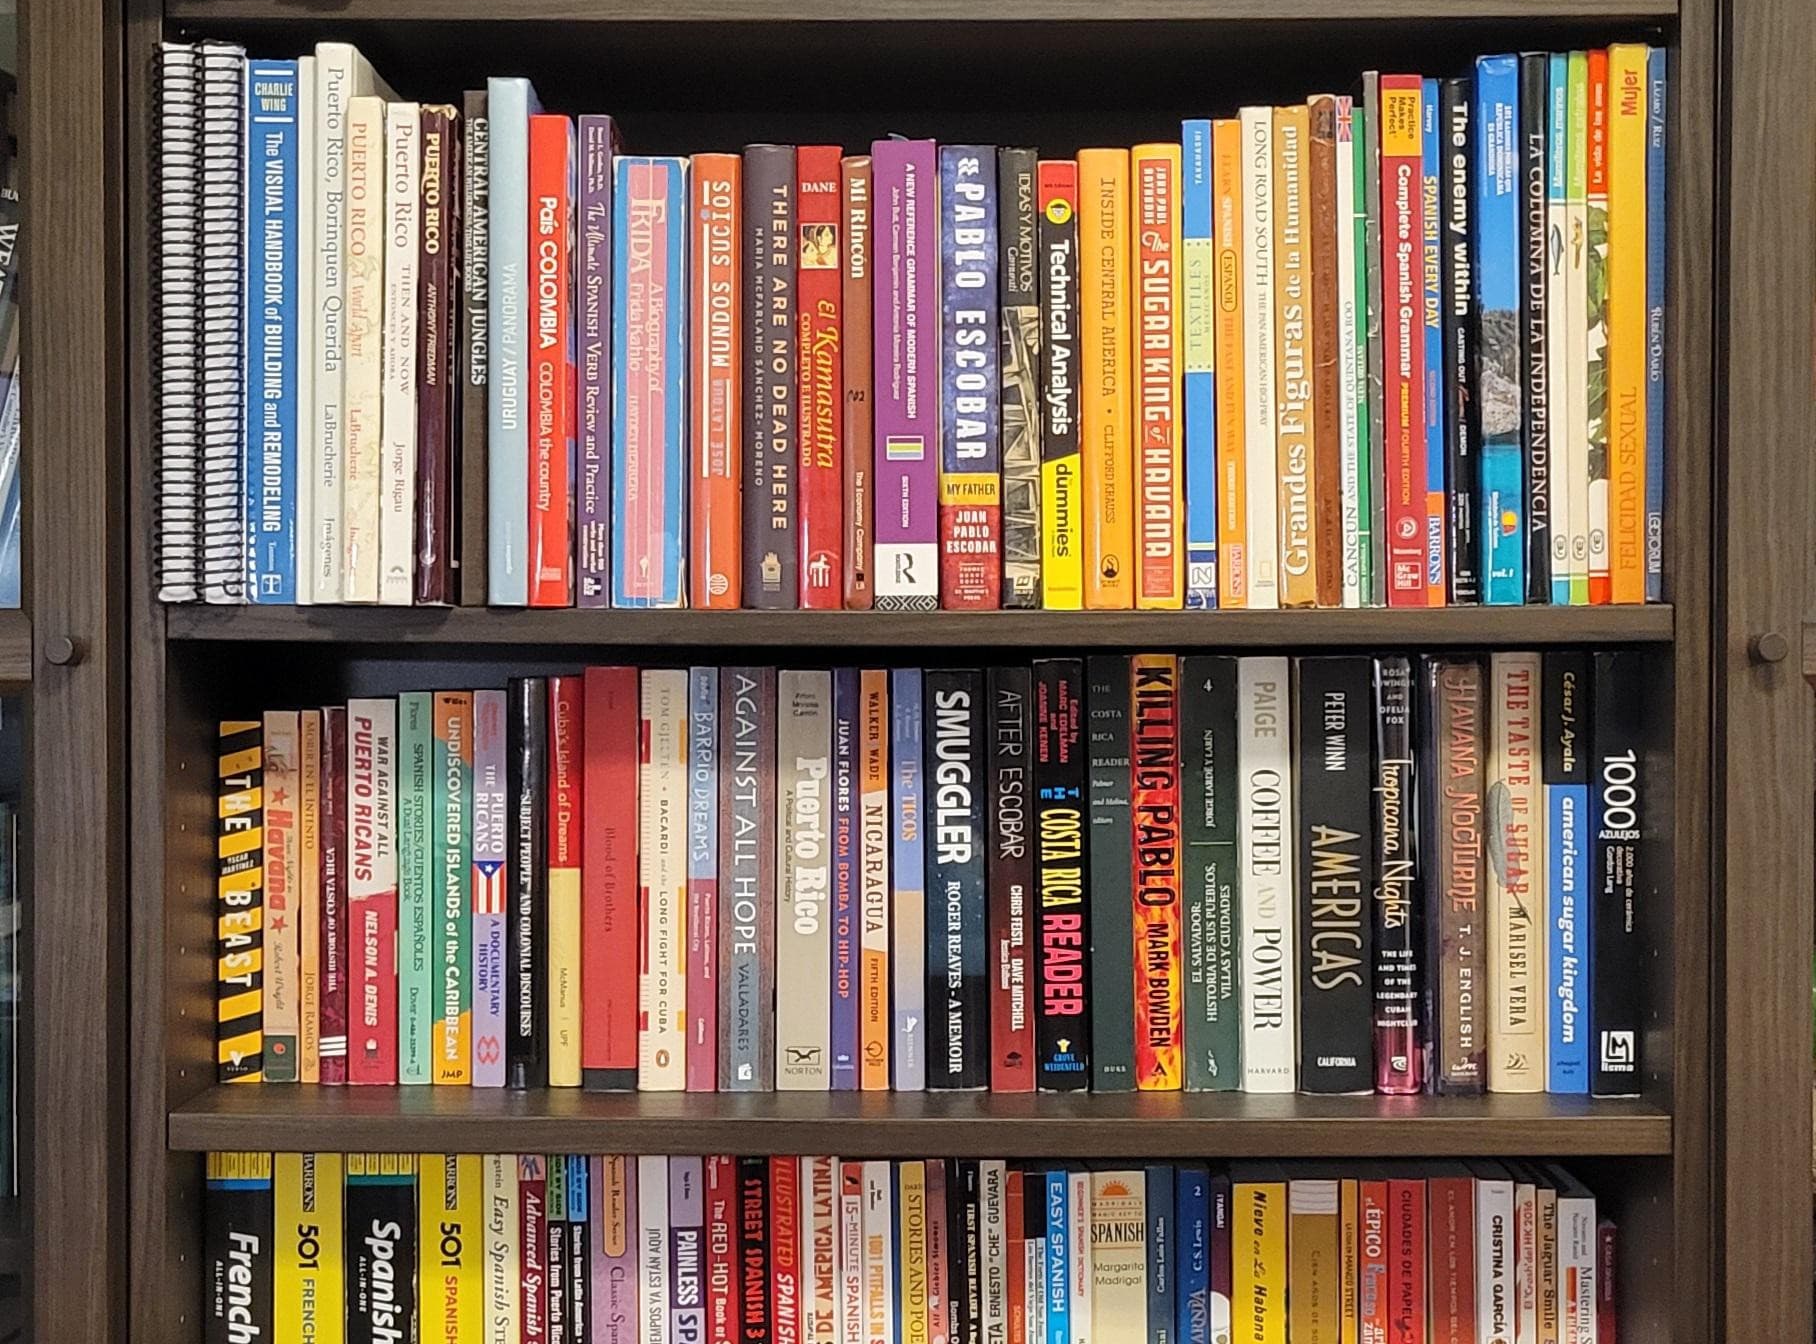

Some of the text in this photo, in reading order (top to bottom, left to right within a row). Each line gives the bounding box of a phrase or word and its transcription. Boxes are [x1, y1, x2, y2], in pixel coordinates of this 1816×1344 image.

[255, 83, 293, 96] CHARLIE
[261, 98, 287, 111] WING
[324, 68, 343, 372] Puerto Rico, Borinquen Querida
[1396, 164, 1413, 378] Complete Spanish Grammar
[1448, 102, 1468, 315] The enemy within
[263, 132, 282, 531] The VISUAL HANDBOOK of BUILDING and REMODELING
[772, 186, 787, 530] THERE ARE NO DEAD HERE
[955, 183, 987, 459] PABLO ESCOBAR
[1049, 240, 1070, 434] Technical Analysis
[1530, 133, 1545, 532] LA COLUMNA DE LA INDEPENDENCIA
[323, 404, 337, 487] LaBrucherie
[1055, 463, 1072, 557] dummies
[354, 716, 372, 881] PUERTO RICANS
[377, 736, 388, 858] WAR AGAINST ALL
[734, 674, 756, 954] AGAINST ALL HOPE
[795, 757, 825, 935] Puerto Rico
[936, 690, 971, 864] SMUGGLER
[1135, 667, 1176, 907] KILLING PABLO
[1603, 749, 1636, 829] 1000
[226, 775, 251, 986] THE BEAST
[446, 717, 460, 1060] UNDISCOVERED ISLANDS of the CARIBBEAN
[865, 804, 884, 933] NICARAGUA
[1041, 809, 1082, 1015] COSTA RICA READER
[1251, 769, 1282, 1031] COFFEE AND POWER
[1310, 825, 1361, 990] AMERICAS
[1561, 797, 1578, 1043] american sugar kingdom
[737, 963, 749, 1051] VALLADARES
[1148, 923, 1170, 1047] MARK BOWDEN
[227, 1232, 260, 1344] French
[298, 1224, 320, 1270] 501
[677, 1231, 698, 1305] PAINLESS
[776, 1159, 795, 1267] ILLUSTRATED
[1492, 1215, 1504, 1279] CRISTINA
[1492, 1285, 1504, 1334] GARCÍA
[1579, 1267, 1593, 1333] Mastering
